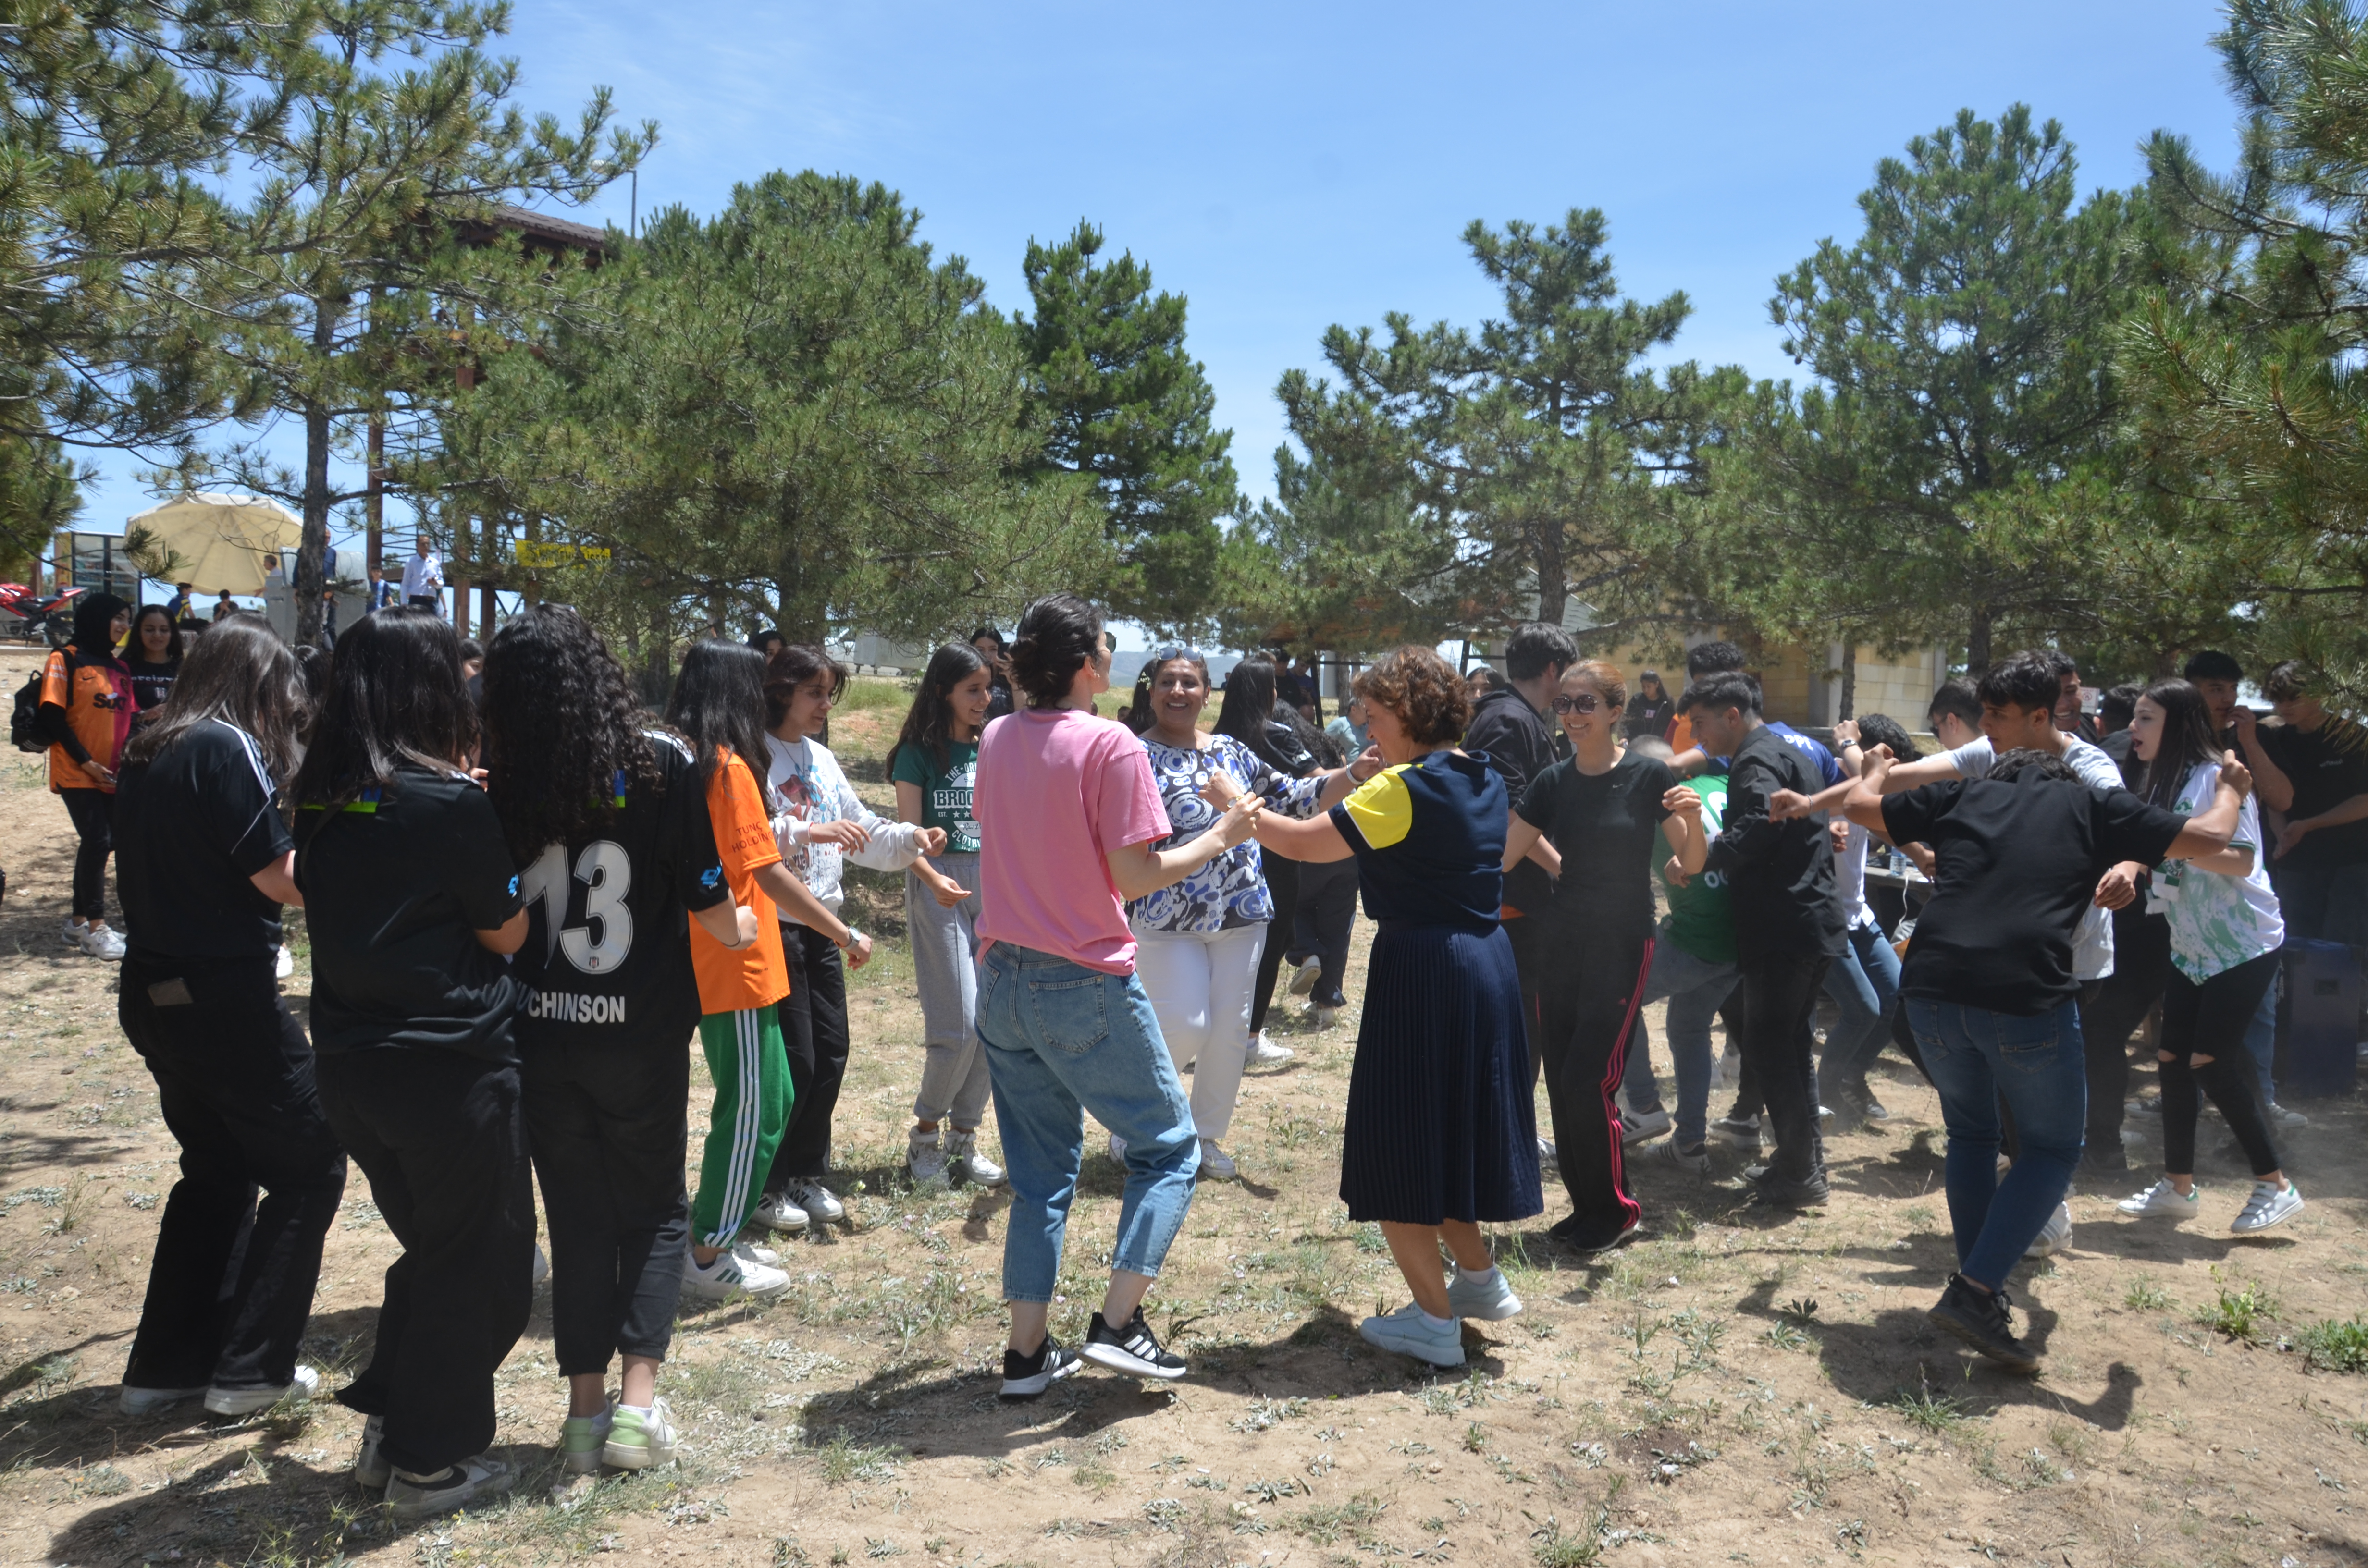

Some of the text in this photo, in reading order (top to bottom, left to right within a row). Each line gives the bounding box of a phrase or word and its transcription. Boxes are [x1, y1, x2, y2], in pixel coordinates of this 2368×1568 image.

[736, 821, 763, 836] TUNÇ
[731, 831, 774, 853] HOLDİNG
[520, 837, 633, 975] 13
